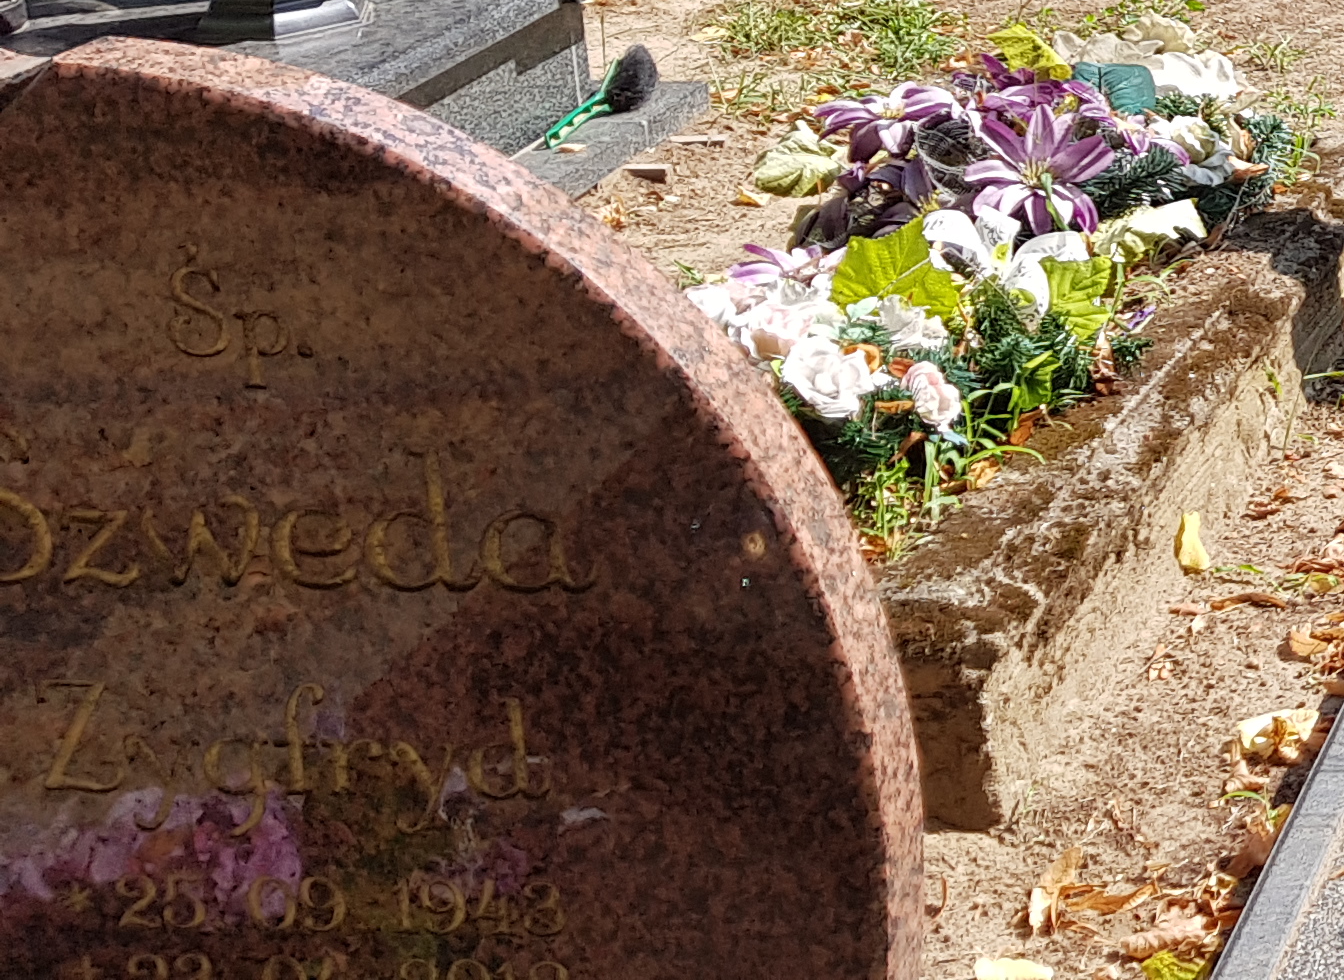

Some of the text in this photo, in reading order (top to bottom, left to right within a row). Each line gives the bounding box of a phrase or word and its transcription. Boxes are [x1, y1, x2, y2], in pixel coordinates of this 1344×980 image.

[42, 678, 553, 837] Zygfryd
[247, 874, 348, 931] 09
[398, 874, 567, 935] 1943
